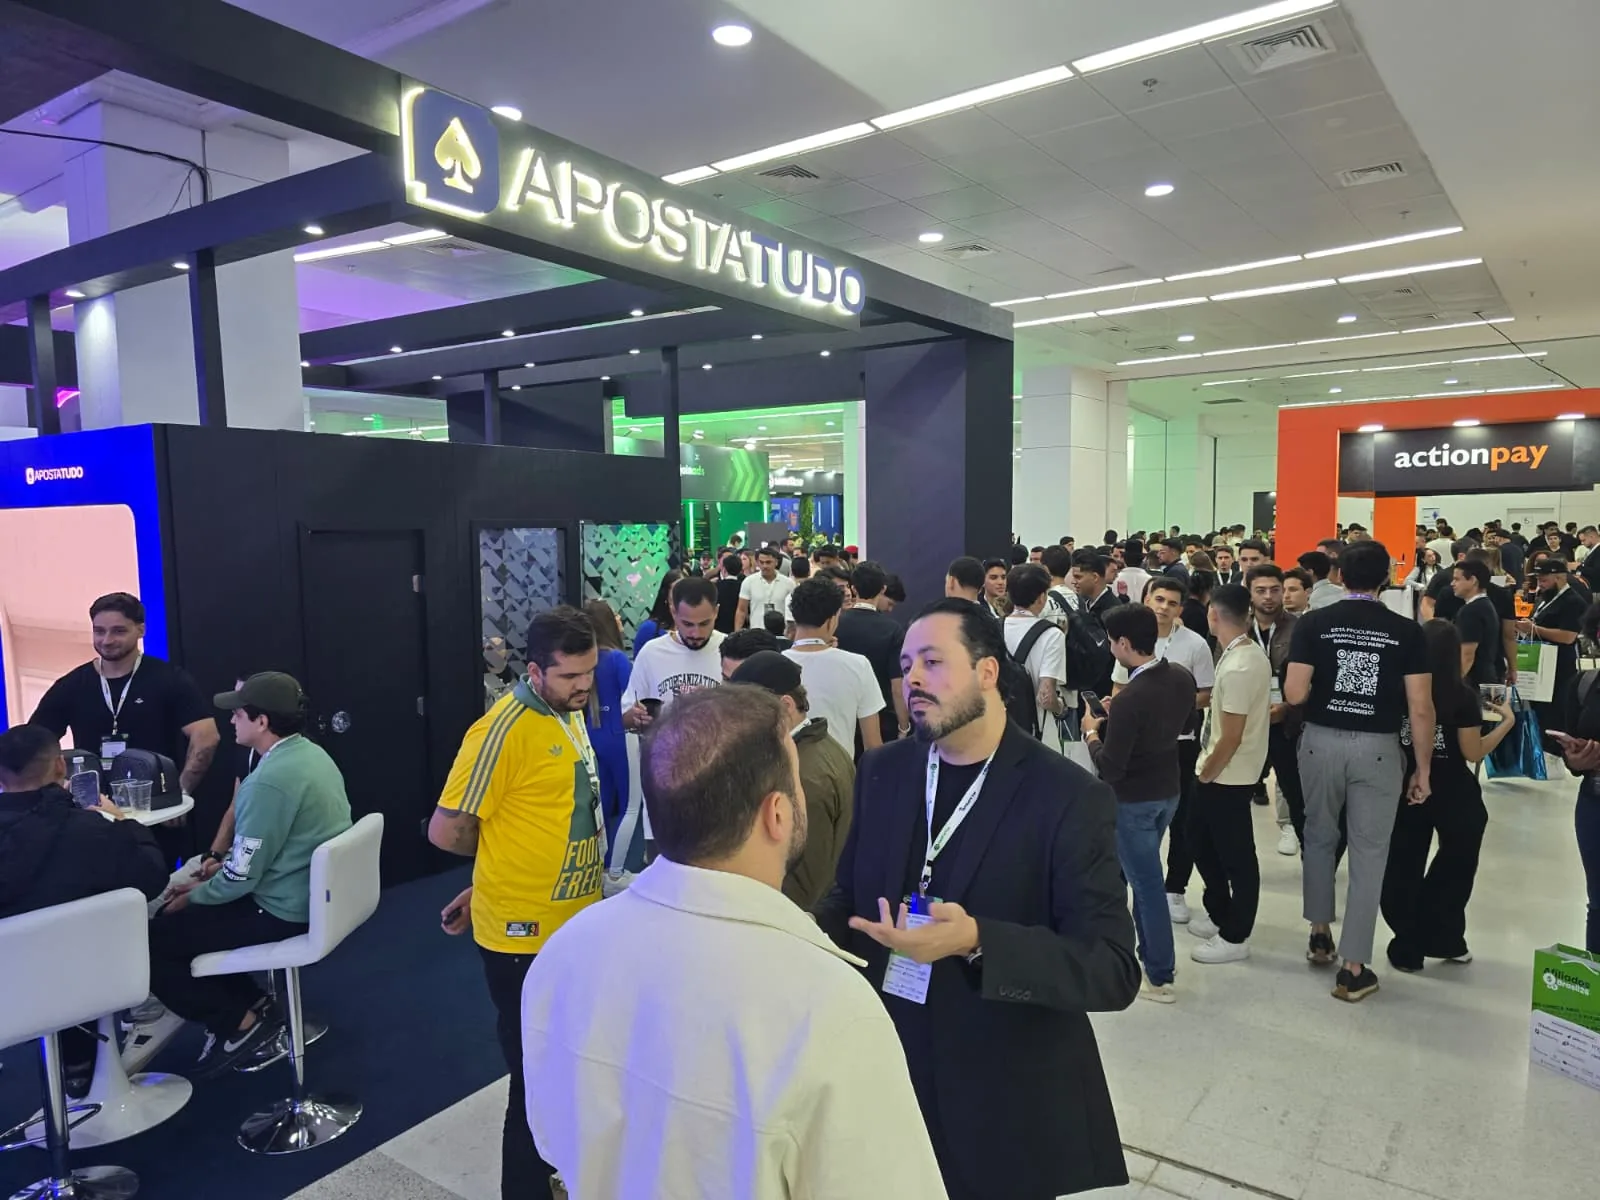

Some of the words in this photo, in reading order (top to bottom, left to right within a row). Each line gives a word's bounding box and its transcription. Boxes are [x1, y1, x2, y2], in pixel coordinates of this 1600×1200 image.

[506, 147, 867, 316] APOSTATUDO
[1394, 443, 1549, 471] actionpay
[34, 466, 83, 481] APOSTATUDO
